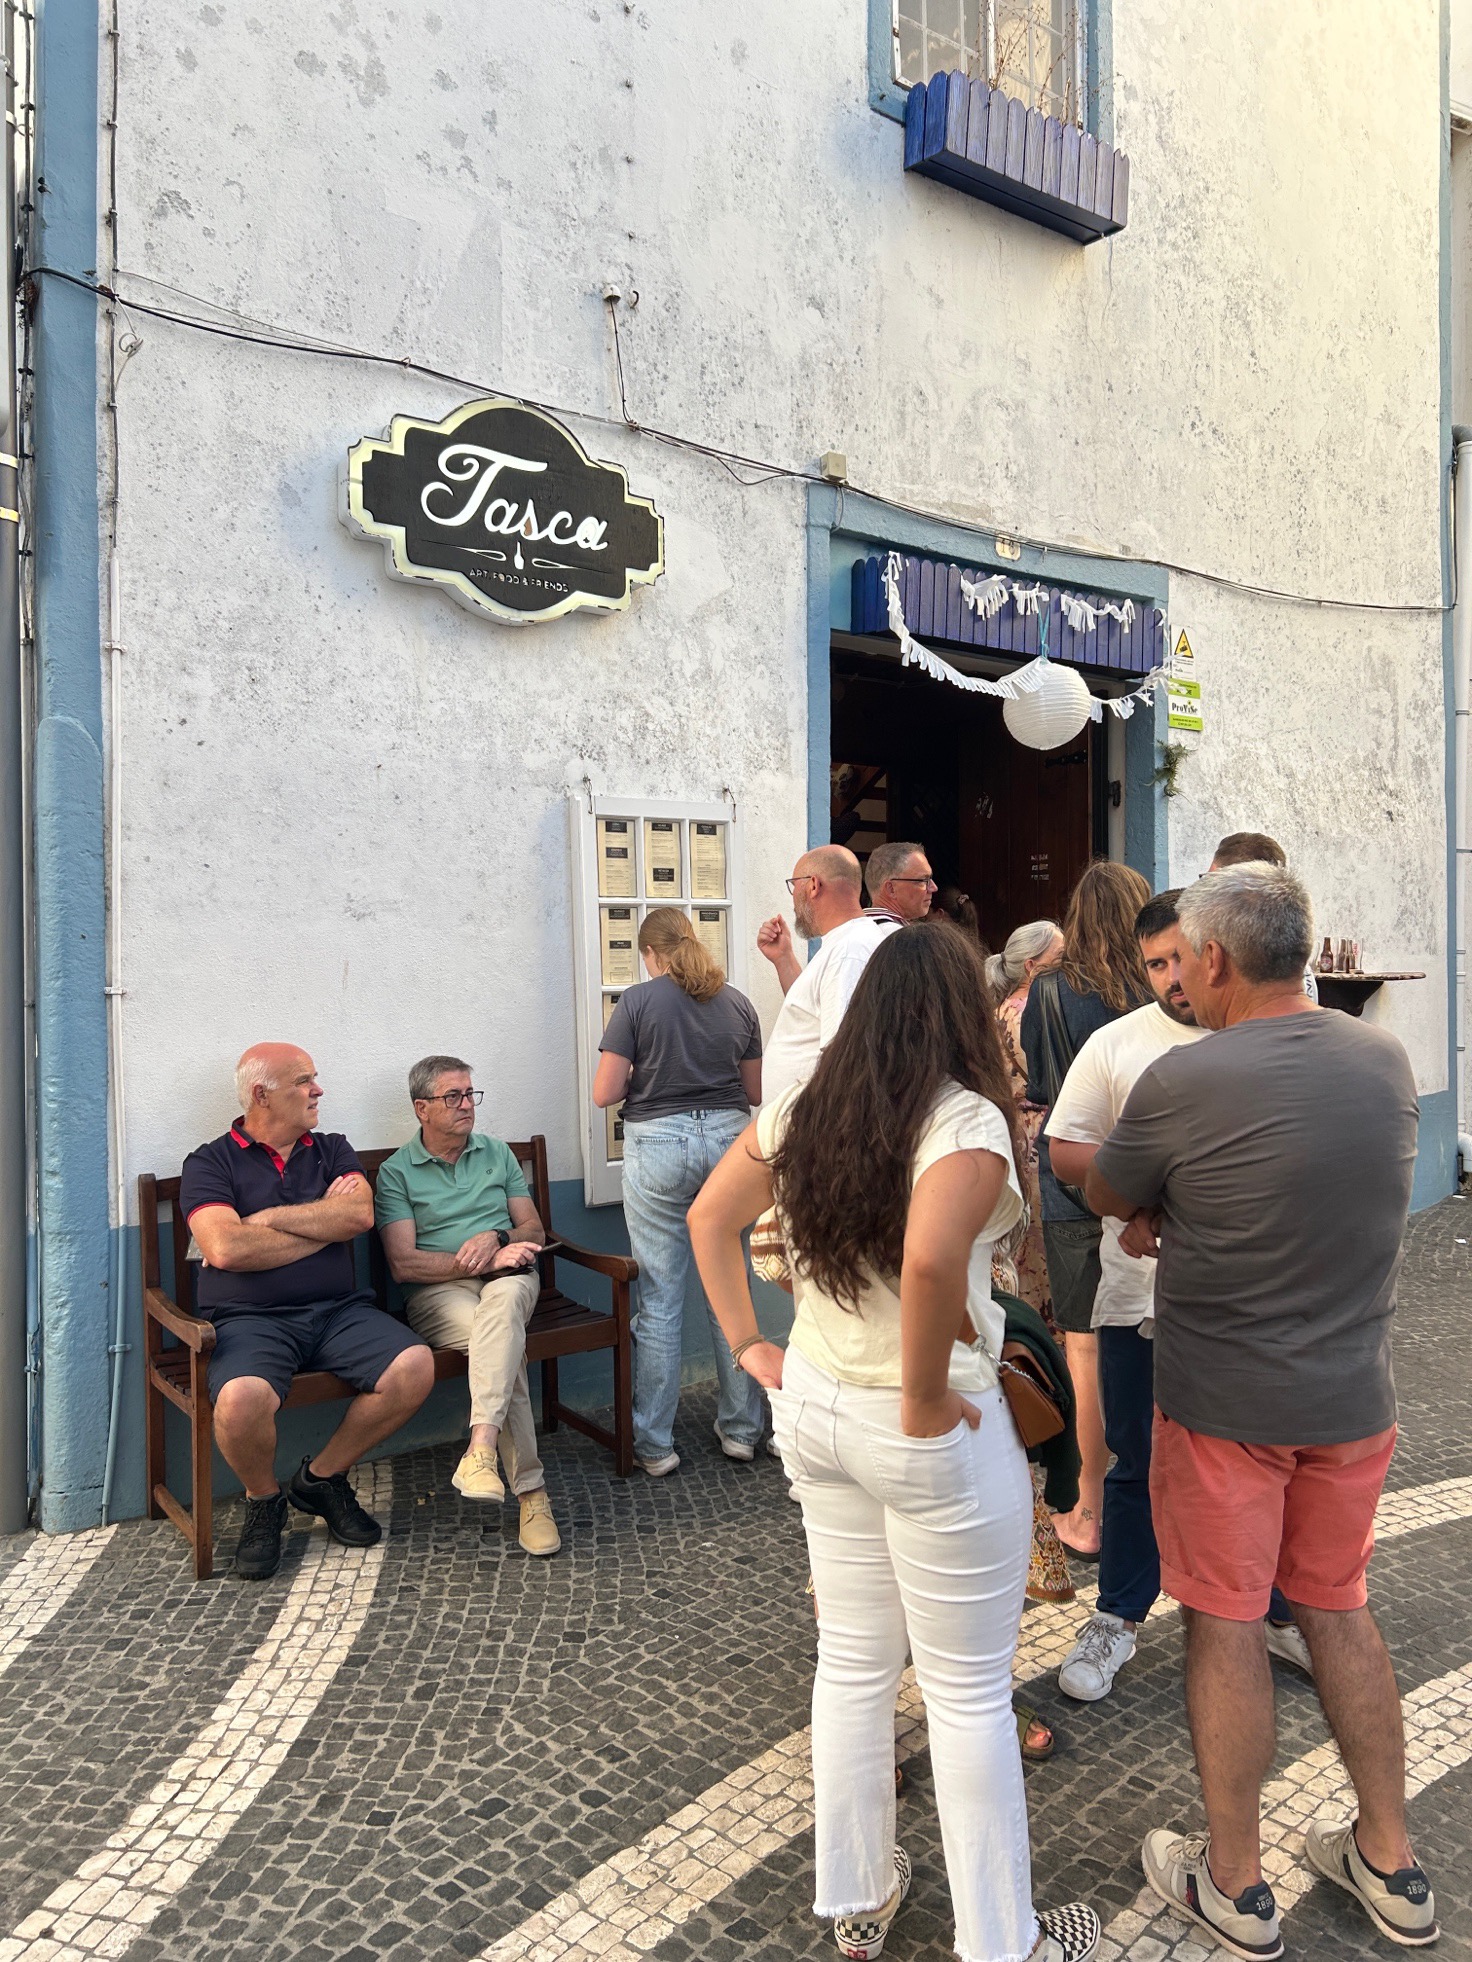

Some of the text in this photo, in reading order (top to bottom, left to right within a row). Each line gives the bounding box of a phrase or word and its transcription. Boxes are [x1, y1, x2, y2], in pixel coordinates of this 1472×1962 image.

[421, 443, 609, 551] Tasca
[493, 571, 520, 585] FOOD
[522, 577, 529, 586] &
[531, 578, 570, 593] FRIENDS
[1407, 1884, 1427, 1895] 1890
